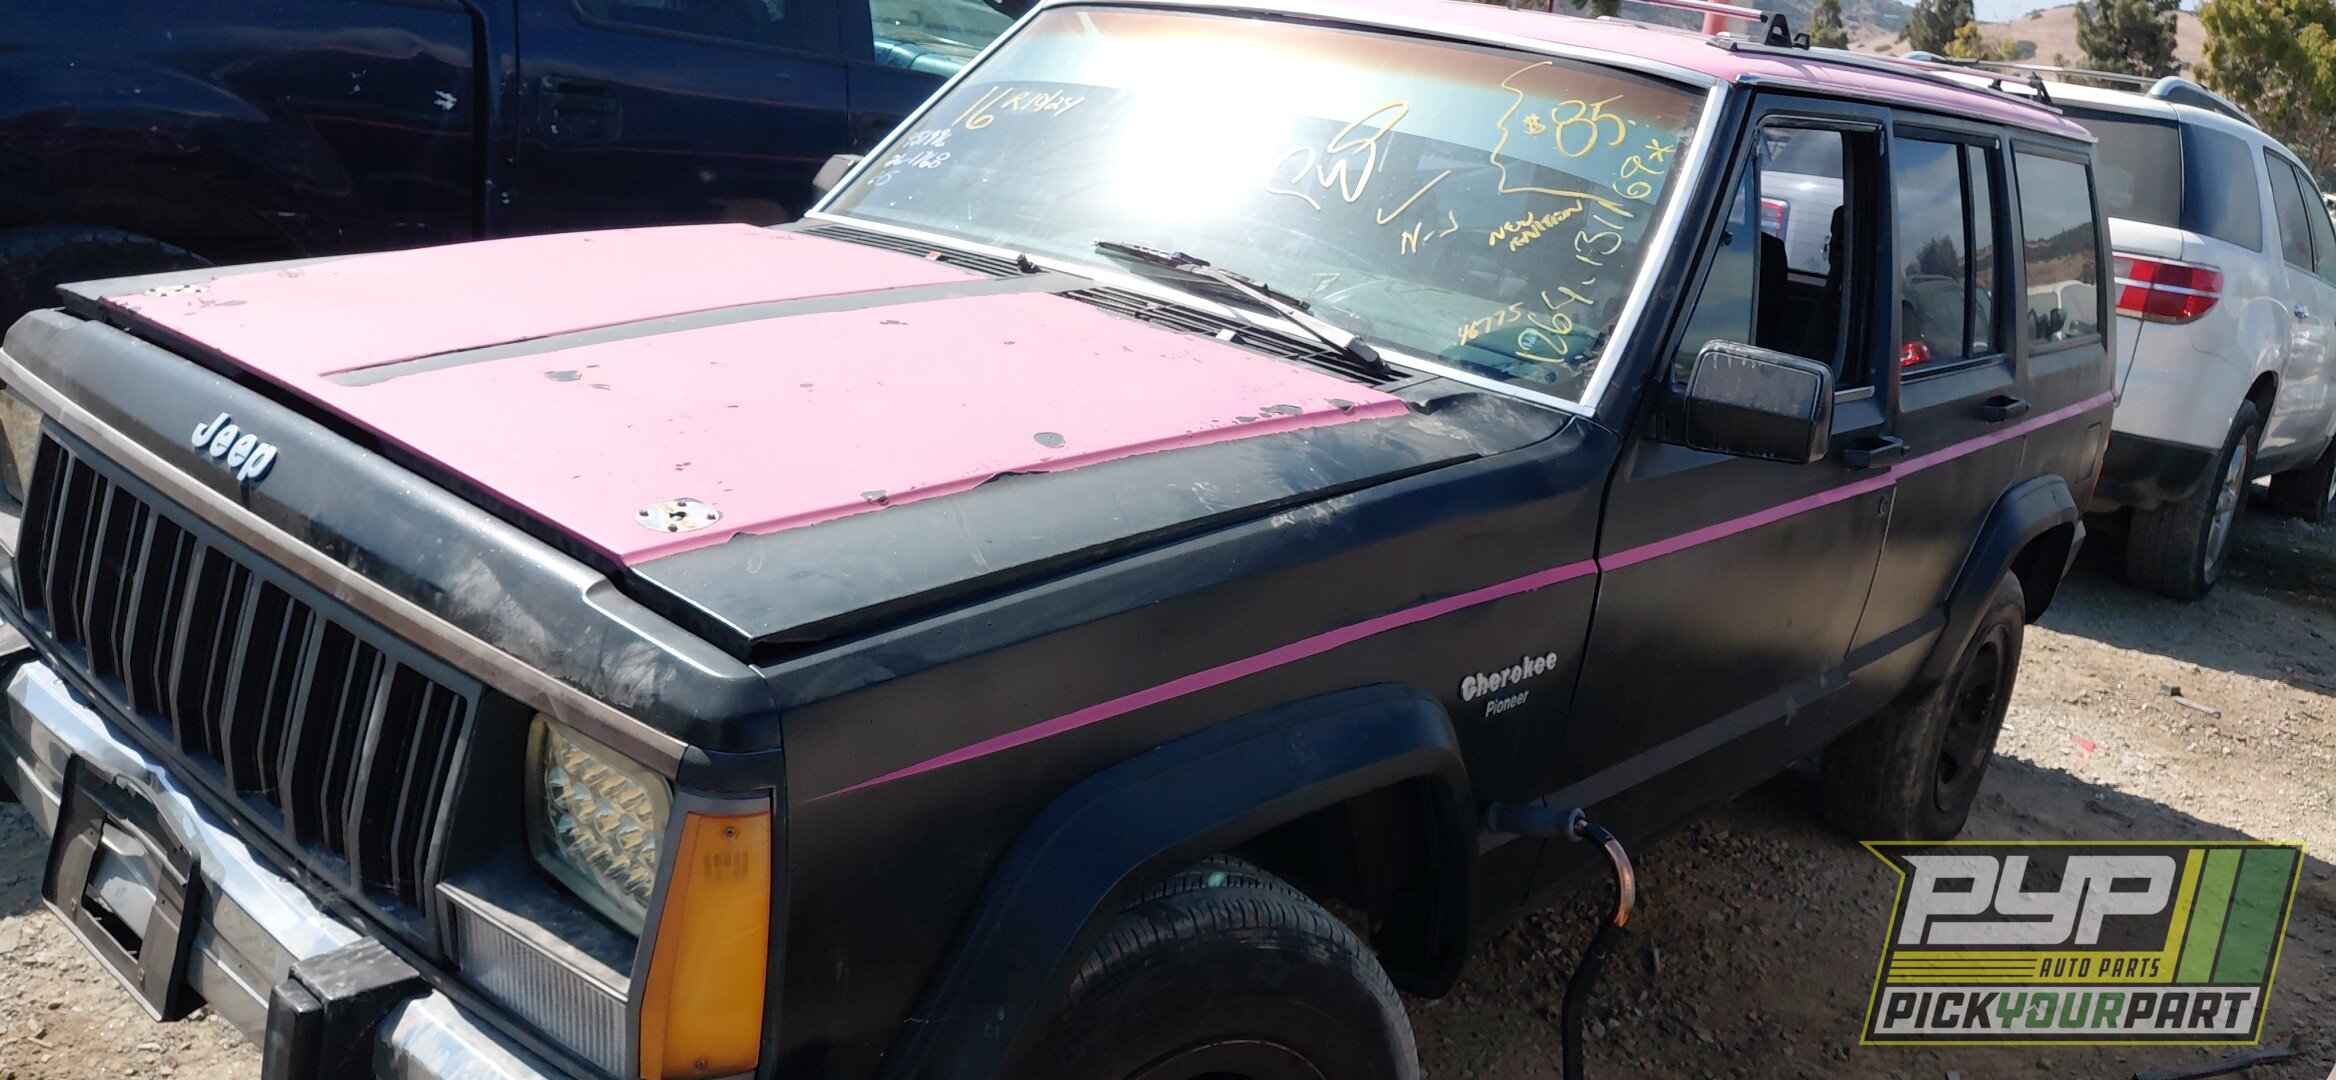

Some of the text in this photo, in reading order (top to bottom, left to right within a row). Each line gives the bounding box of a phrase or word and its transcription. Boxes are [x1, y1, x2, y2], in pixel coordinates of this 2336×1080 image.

[190, 411, 278, 481] Jeep
[1460, 651, 1558, 702] Cherokee
[1485, 690, 1530, 718] Pioneer
